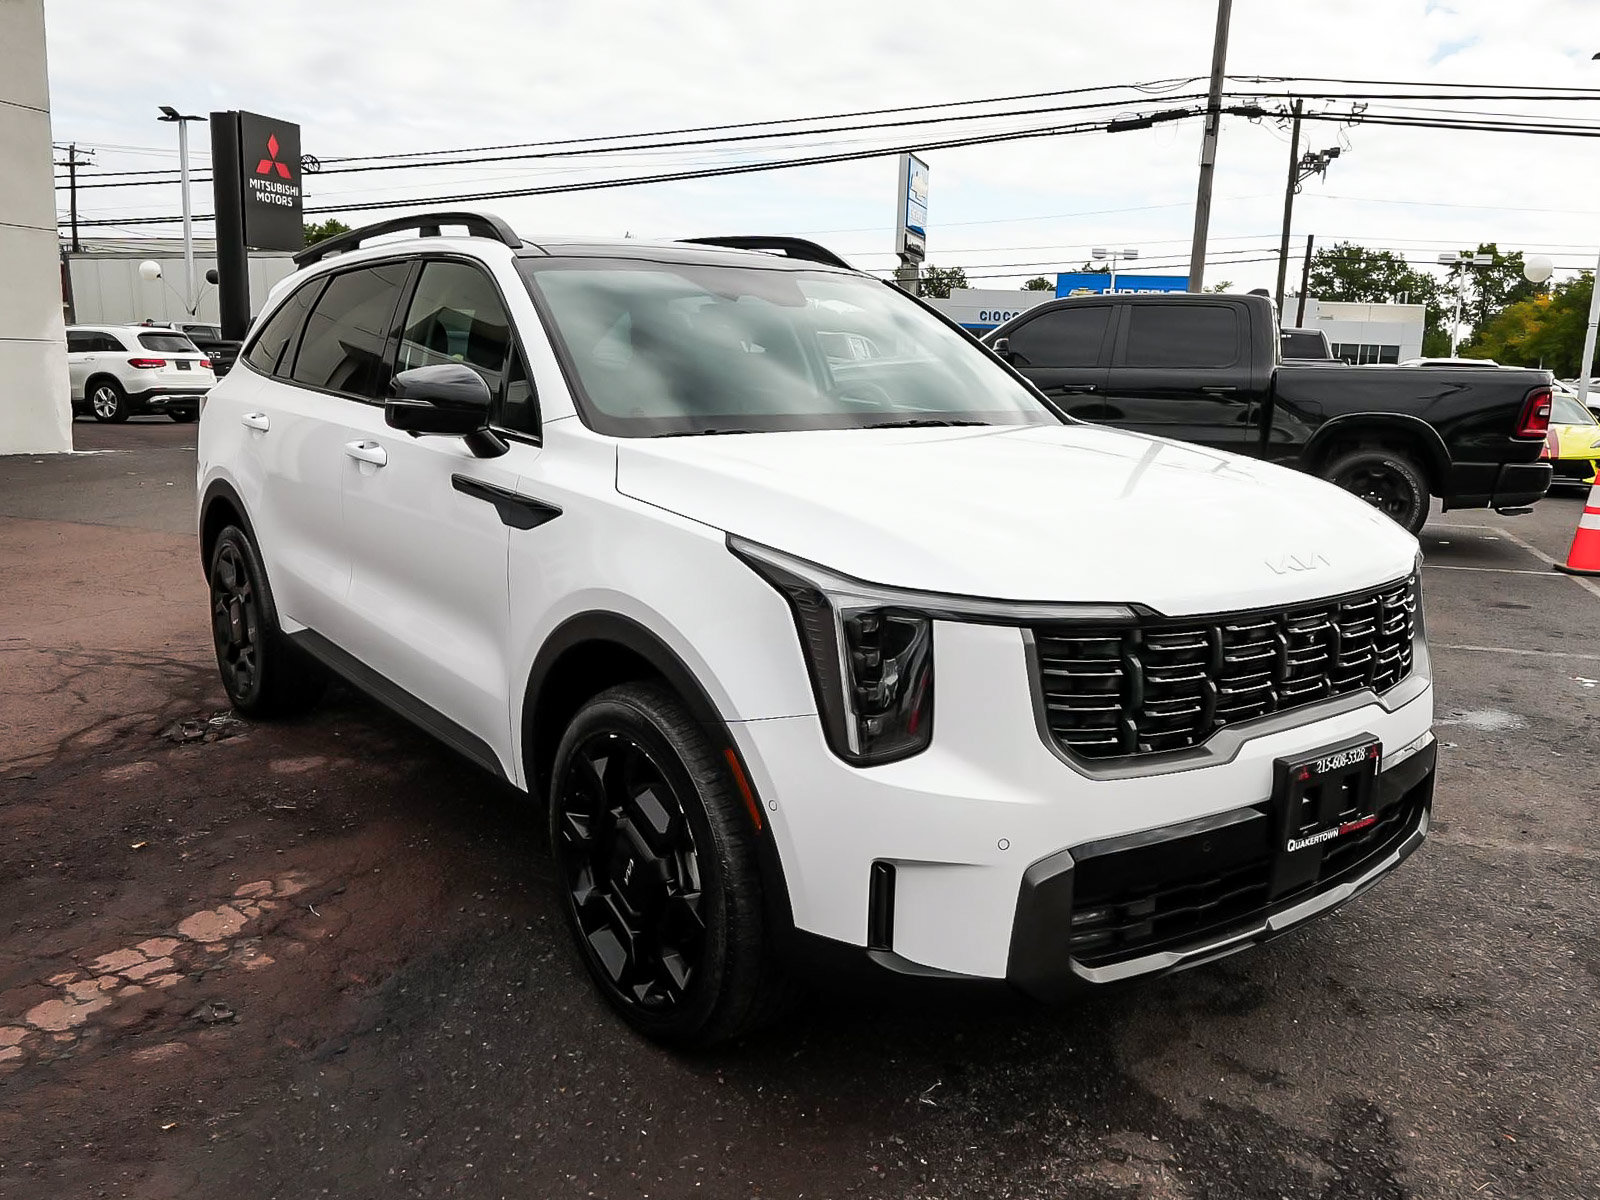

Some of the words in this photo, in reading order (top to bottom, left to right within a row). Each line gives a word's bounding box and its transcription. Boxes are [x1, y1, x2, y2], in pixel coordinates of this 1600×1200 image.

[249, 178, 299, 197] MITSUBISHI
[256, 191, 293, 207] MOTORS
[1287, 827, 1339, 853] QUAKERTOWN
